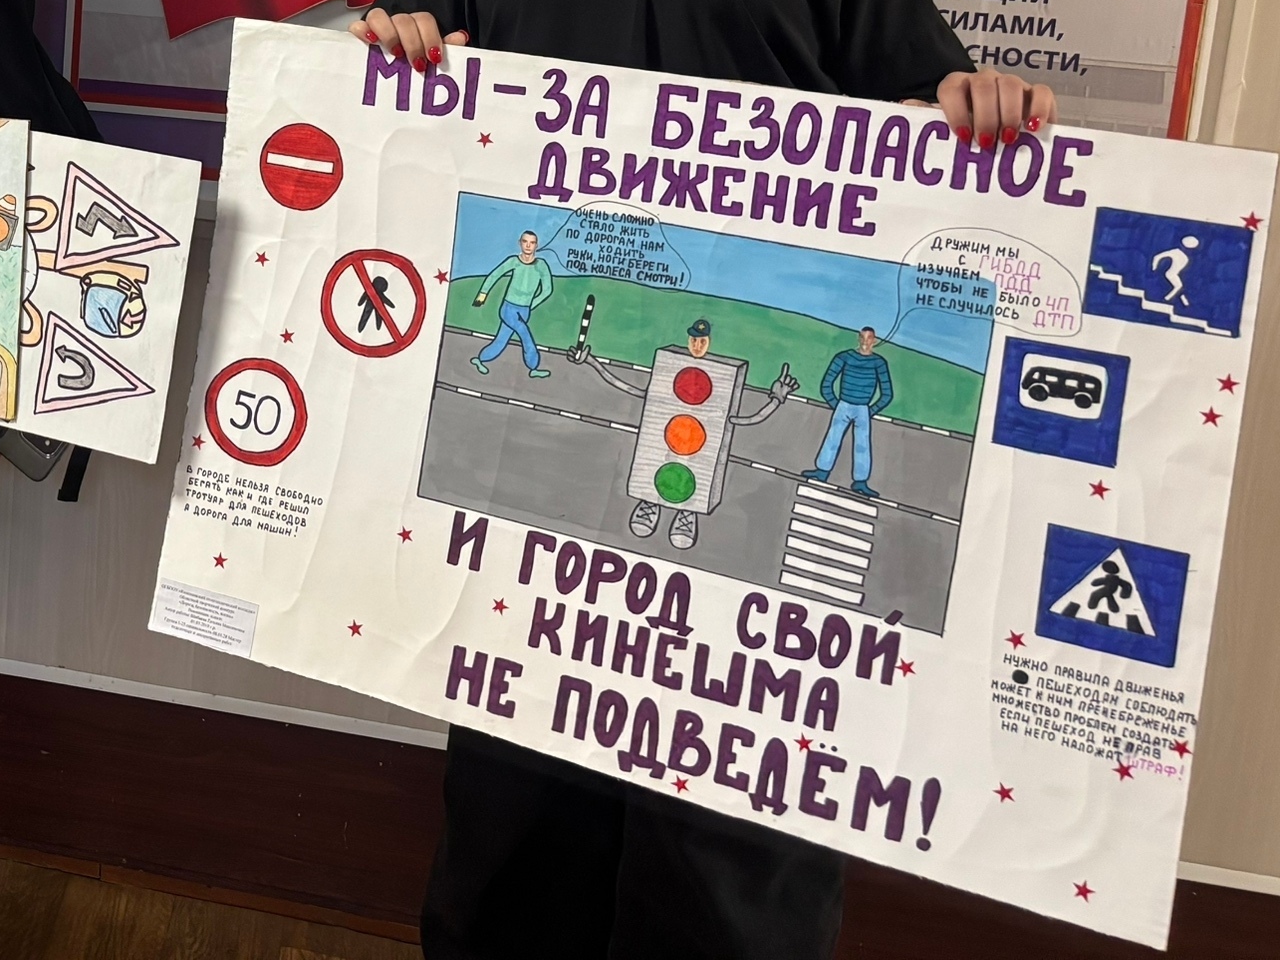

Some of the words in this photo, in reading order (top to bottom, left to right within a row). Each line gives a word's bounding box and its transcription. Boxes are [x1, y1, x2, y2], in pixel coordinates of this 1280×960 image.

[651, 83, 1094, 208] БЕЗОПАСНОЕ
[528, 141, 877, 236] ДВИЖЕНИЕ
[575, 208, 609, 220] ОЧЕНЬ
[612, 212, 654, 226] СЛОЖНО
[580, 219, 615, 233] СТАЛО
[620, 225, 650, 238] ЖИТЬ
[584, 232, 635, 248] ДОРОГАМ
[640, 240, 665, 252] НАМ
[599, 244, 645, 259] ХОДИТЬ
[930, 236, 991, 255] ДРУЖИМ
[995, 246, 1020, 258] МЫ
[591, 264, 631, 279] КОЛЕСА
[628, 259, 669, 273] БЕРЕГИ
[917, 262, 981, 281] ИЗУЧАЕМ
[994, 273, 1032, 294] ПДД
[979, 254, 1041, 280] ГИБДД
[916, 277, 962, 294] ЧТОБЫ
[999, 291, 1041, 308] БЫЛО
[938, 297, 1020, 320] СЛУЧИЛОСЬ
[1032, 309, 1074, 330] ДТП
[229, 390, 282, 436] 50
[235, 477, 270, 493] НЕЛЬЗЯ
[275, 486, 324, 506] СВОБОДНО
[446, 510, 489, 572] И
[519, 530, 694, 637] ГОРОД
[737, 591, 903, 686] СВОЙ
[528, 597, 839, 731] КИНЕШМА
[1003, 653, 1049, 672] НУЖНО
[1054, 665, 1110, 687] ПРАВИЛА
[445, 645, 522, 719] НЕ
[551, 674, 942, 851] ПОДВЕДЁМ!
